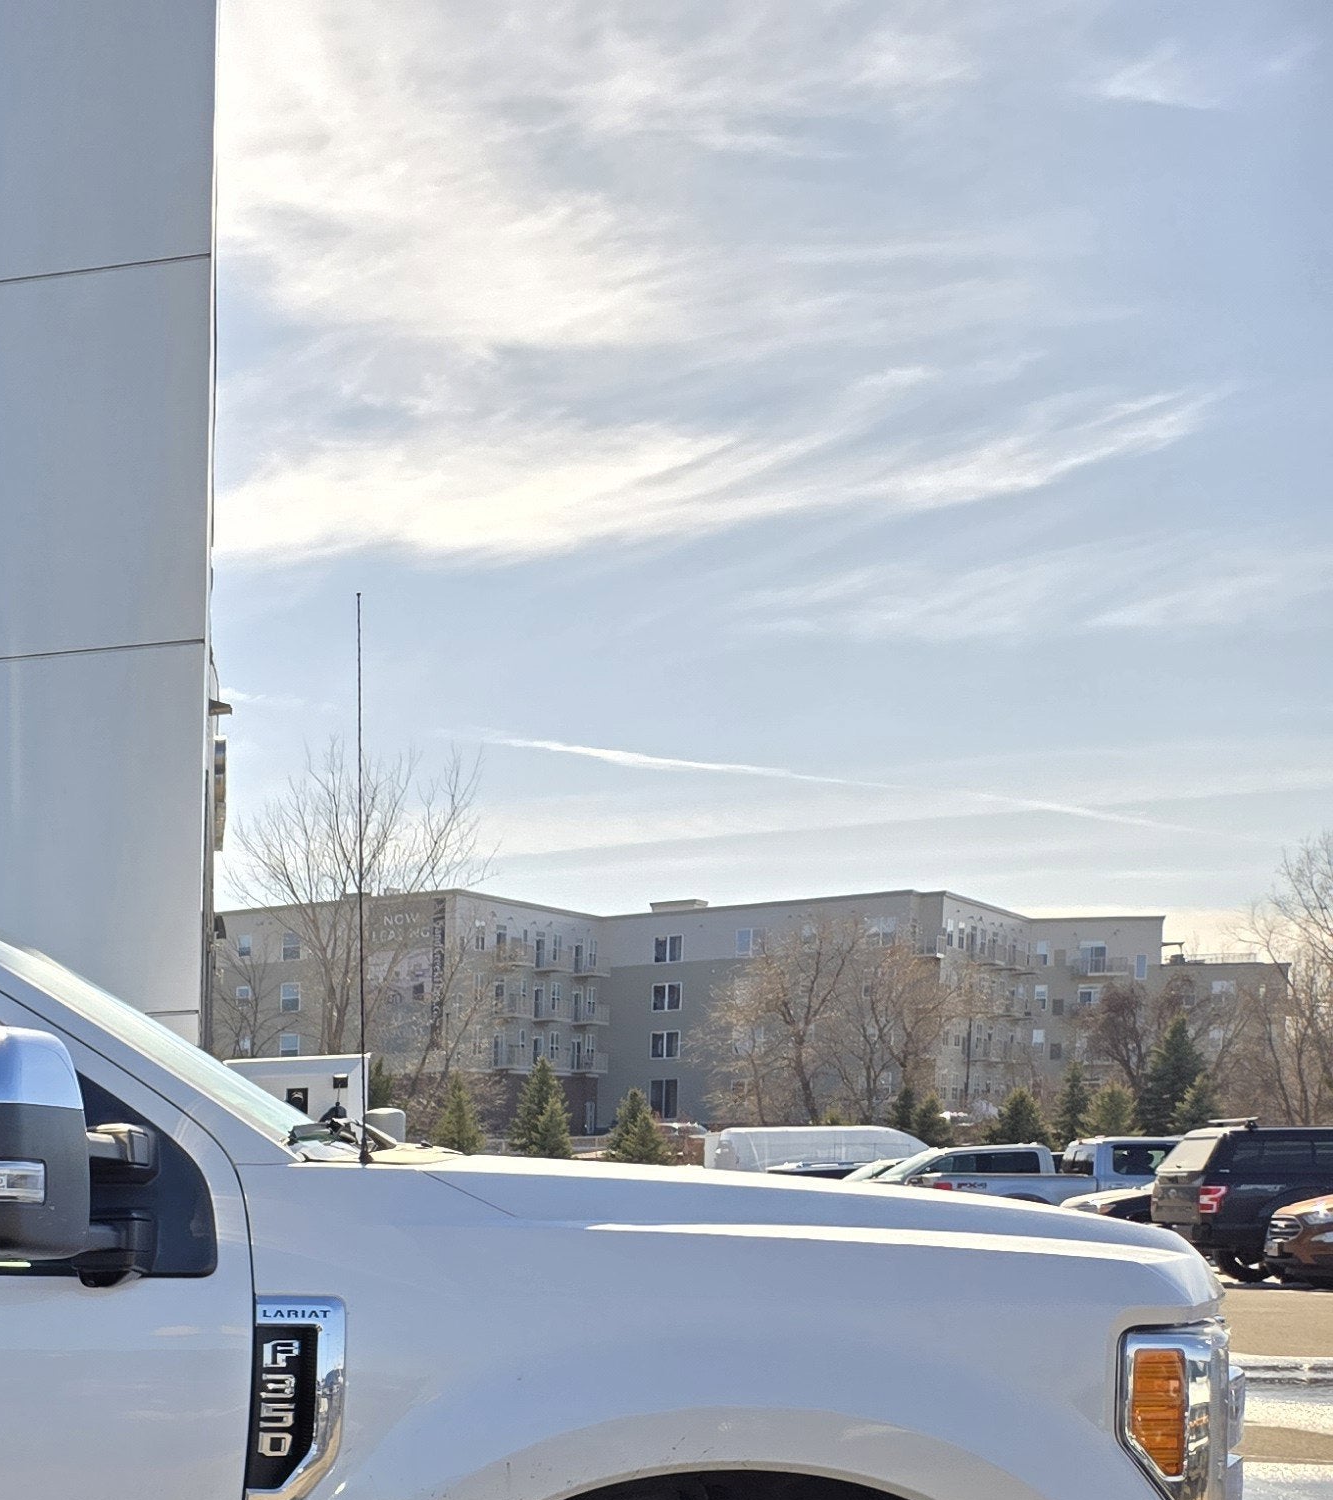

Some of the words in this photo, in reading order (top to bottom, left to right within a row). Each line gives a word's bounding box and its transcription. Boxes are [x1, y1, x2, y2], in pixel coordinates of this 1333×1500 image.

[383, 911, 420, 926] NOW
[371, 926, 431, 943] LEANG
[262, 1309, 332, 1319] LARIAT
[257, 1339, 301, 1458] F350
